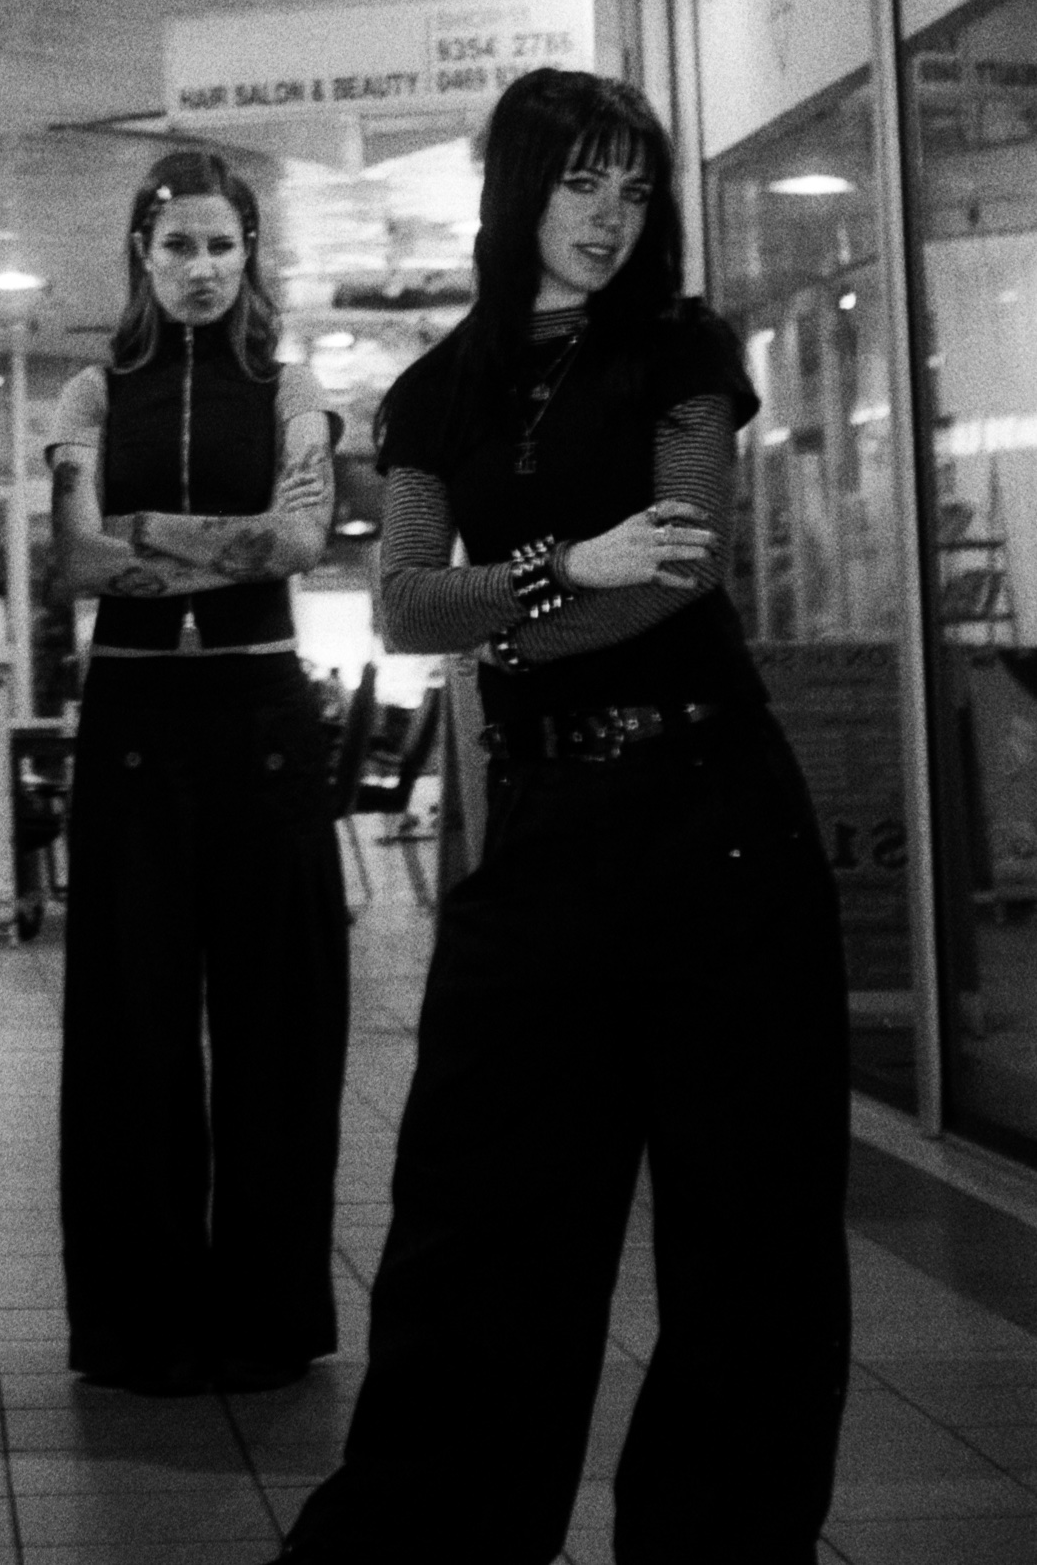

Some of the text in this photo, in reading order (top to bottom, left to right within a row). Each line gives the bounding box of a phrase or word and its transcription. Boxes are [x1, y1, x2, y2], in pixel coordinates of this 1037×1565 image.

[179, 85, 227, 110] HAIR
[234, 79, 304, 107] SALON
[333, 72, 419, 102] BEAUTY
